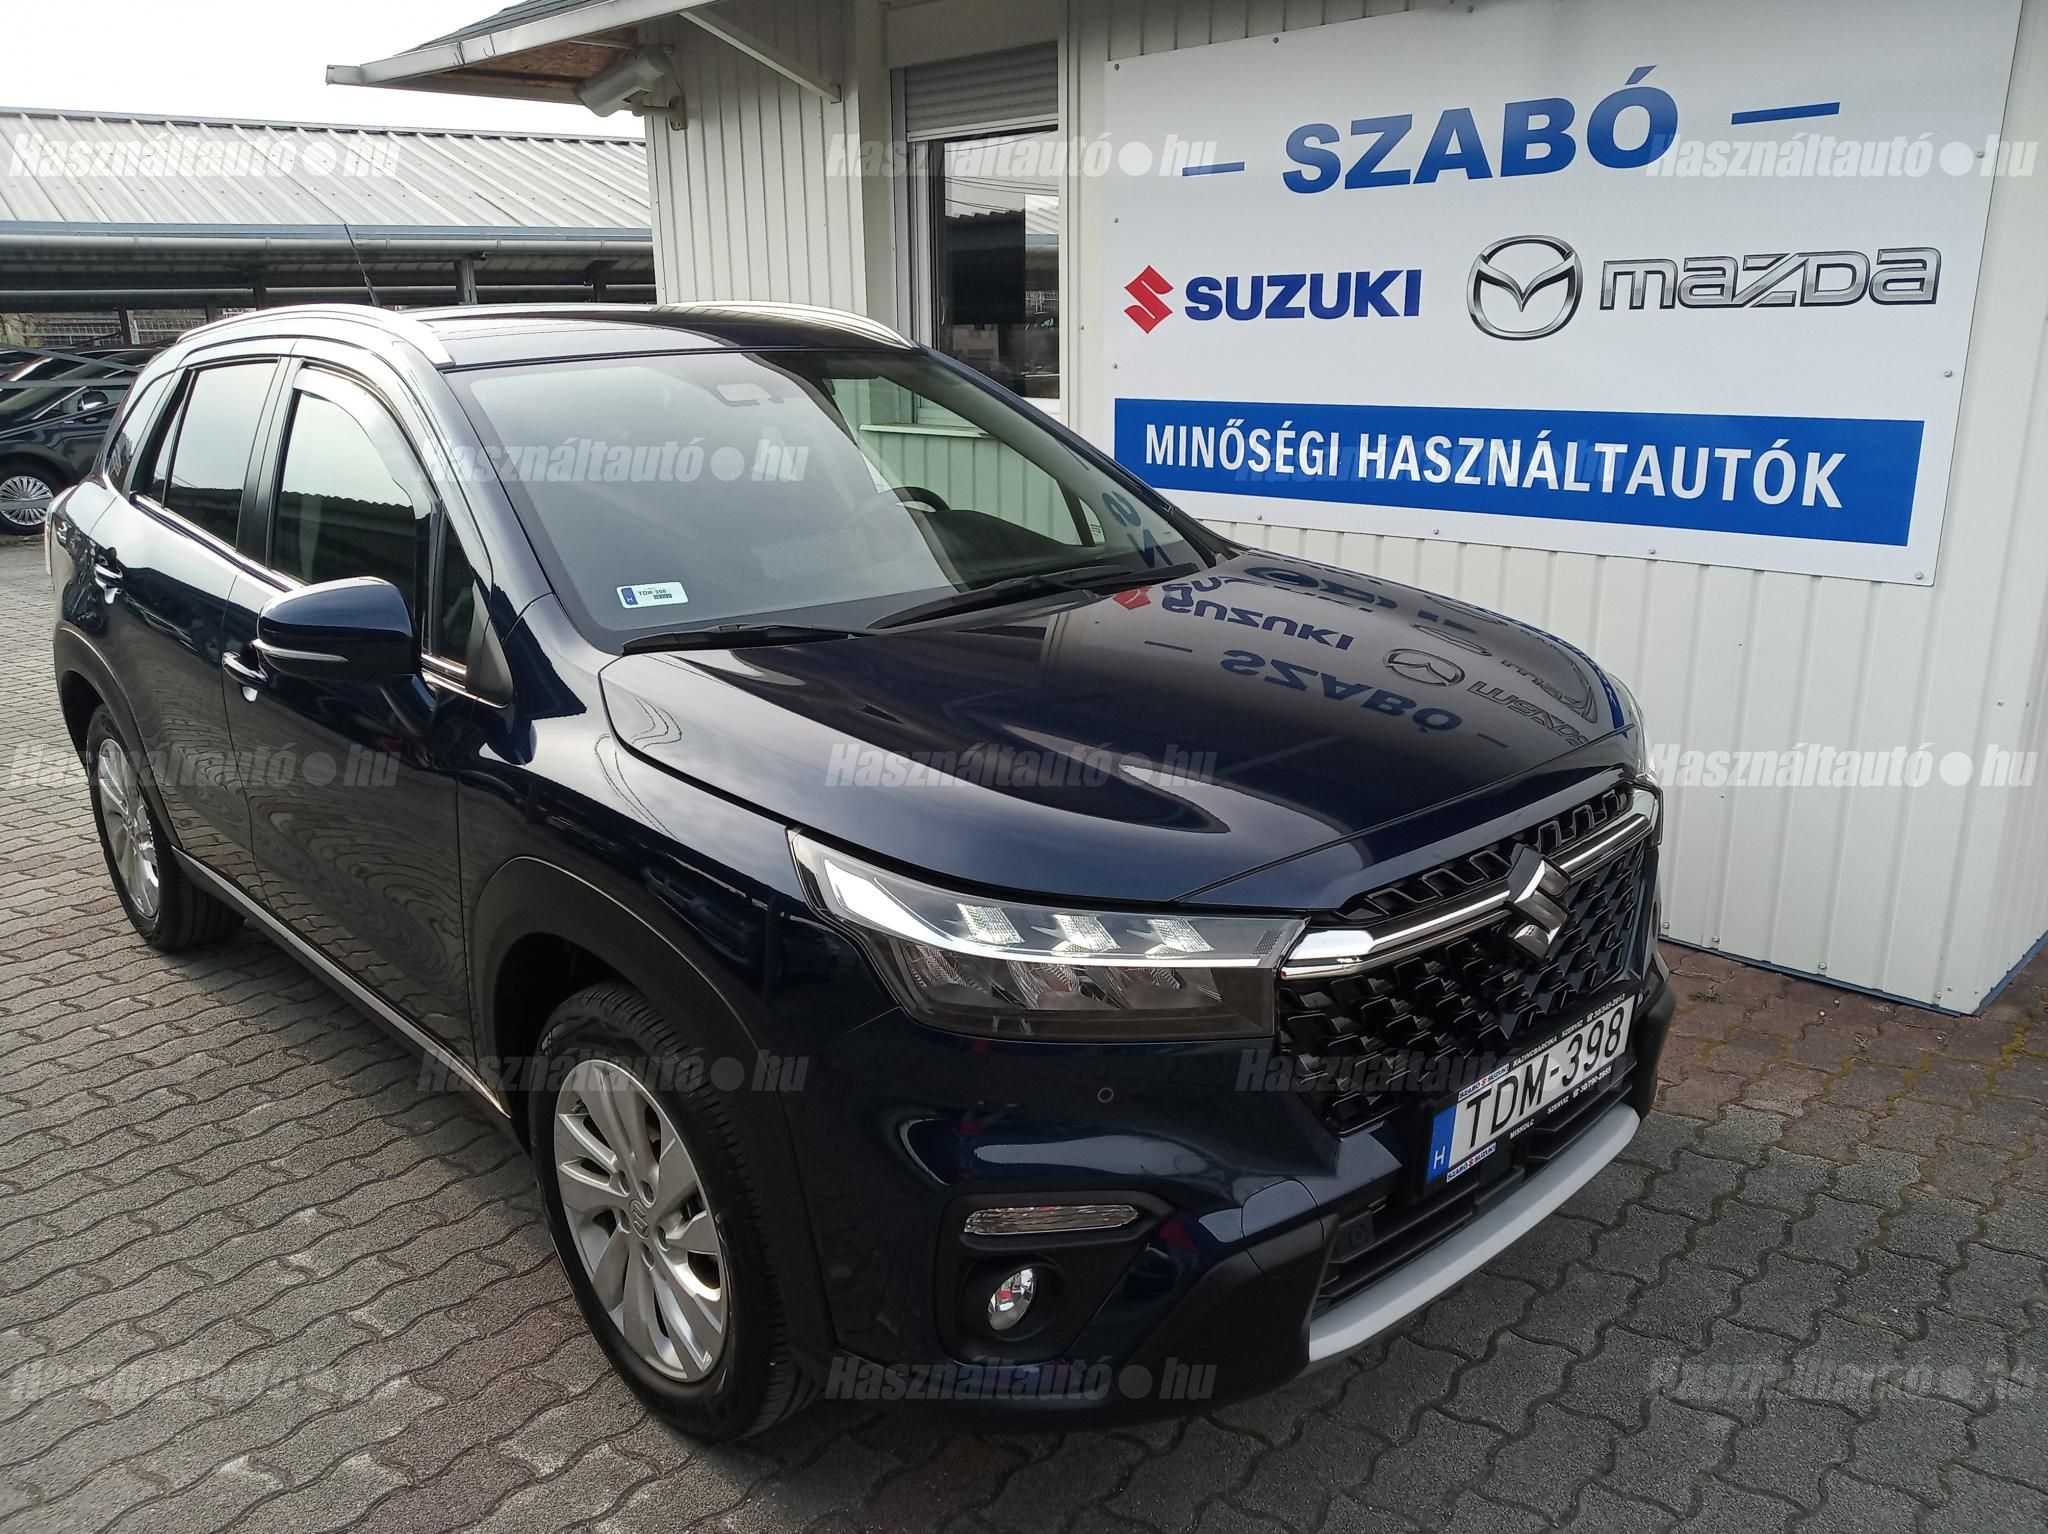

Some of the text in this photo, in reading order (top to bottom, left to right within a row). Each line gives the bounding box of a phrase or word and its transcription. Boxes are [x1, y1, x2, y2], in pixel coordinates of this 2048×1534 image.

[1284, 66, 1678, 194] SZABÓ
[1184, 269, 1422, 322] SUZUKI
[1145, 418, 1845, 509] MINŐSÉGI HASZNÁLTAUTÓK
[1466, 1006, 1625, 1149] TDM-398
[1433, 1145, 1446, 1170] H
